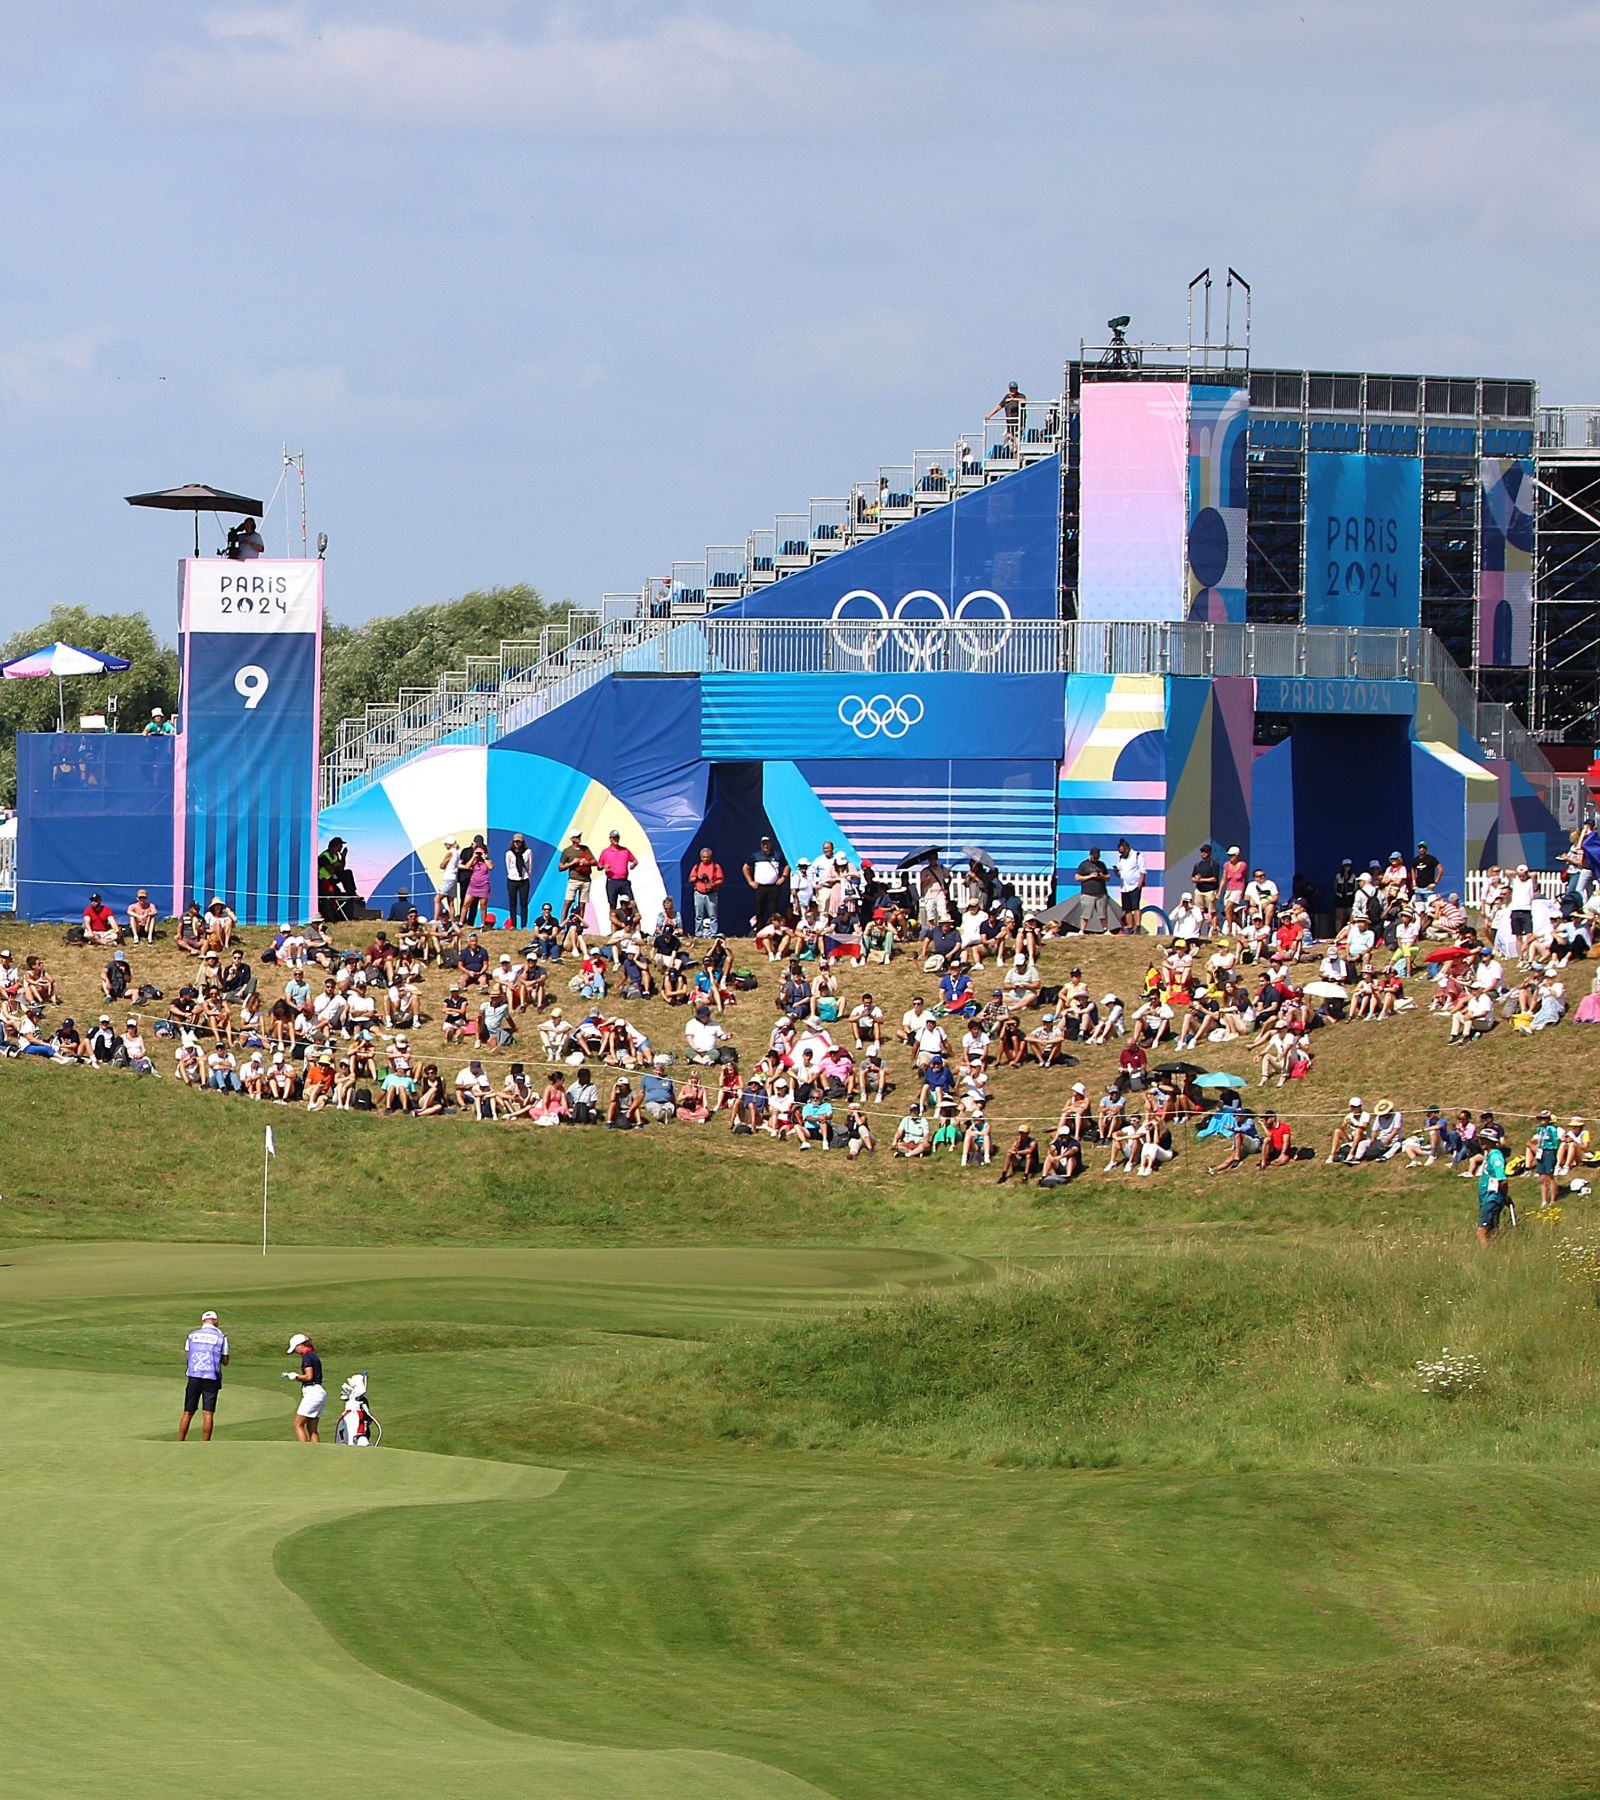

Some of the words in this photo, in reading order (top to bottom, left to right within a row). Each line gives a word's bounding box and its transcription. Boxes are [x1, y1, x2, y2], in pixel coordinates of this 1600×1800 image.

[1326, 561, 1397, 598] 2024
[221, 597, 286, 614] 2024
[234, 665, 269, 709] 9
[1343, 683, 1391, 711] 2024
